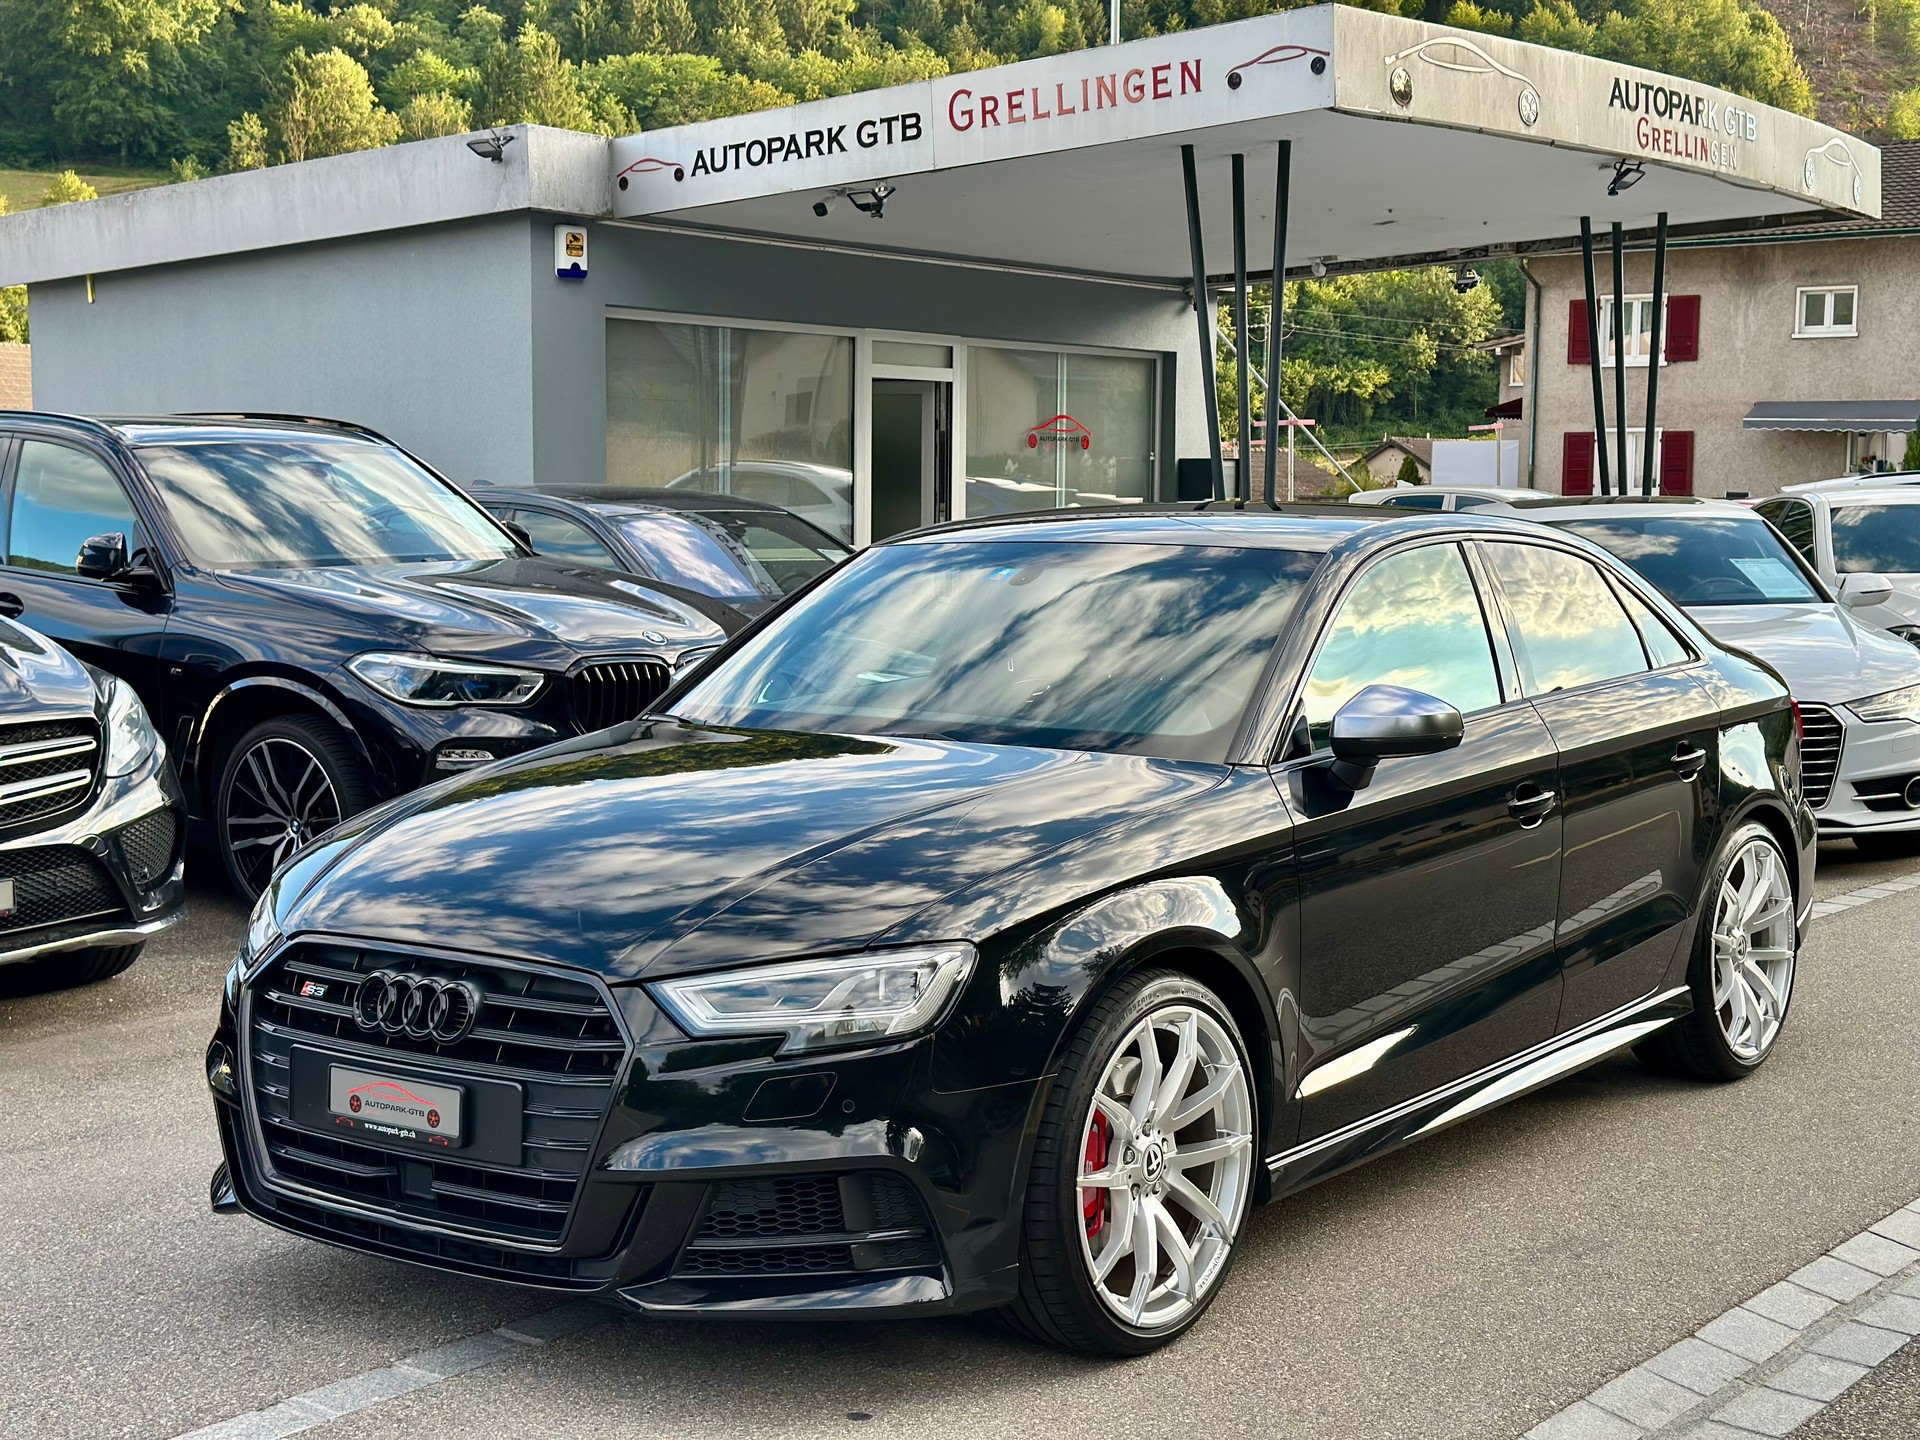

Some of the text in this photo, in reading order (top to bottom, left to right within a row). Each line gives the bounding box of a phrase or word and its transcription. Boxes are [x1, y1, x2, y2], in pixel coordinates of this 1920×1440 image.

[691, 58, 1202, 178] AUTOPARK GTB GRELLINGEN
[1608, 77, 1757, 142] AUTOPARK GTB
[1637, 116, 1737, 170] GRELLINGEN
[306, 984, 326, 997] S3
[364, 1099, 425, 1117] AUTOPARK-GTB
[364, 1122, 416, 1139] www.autopark-gtb.ch
